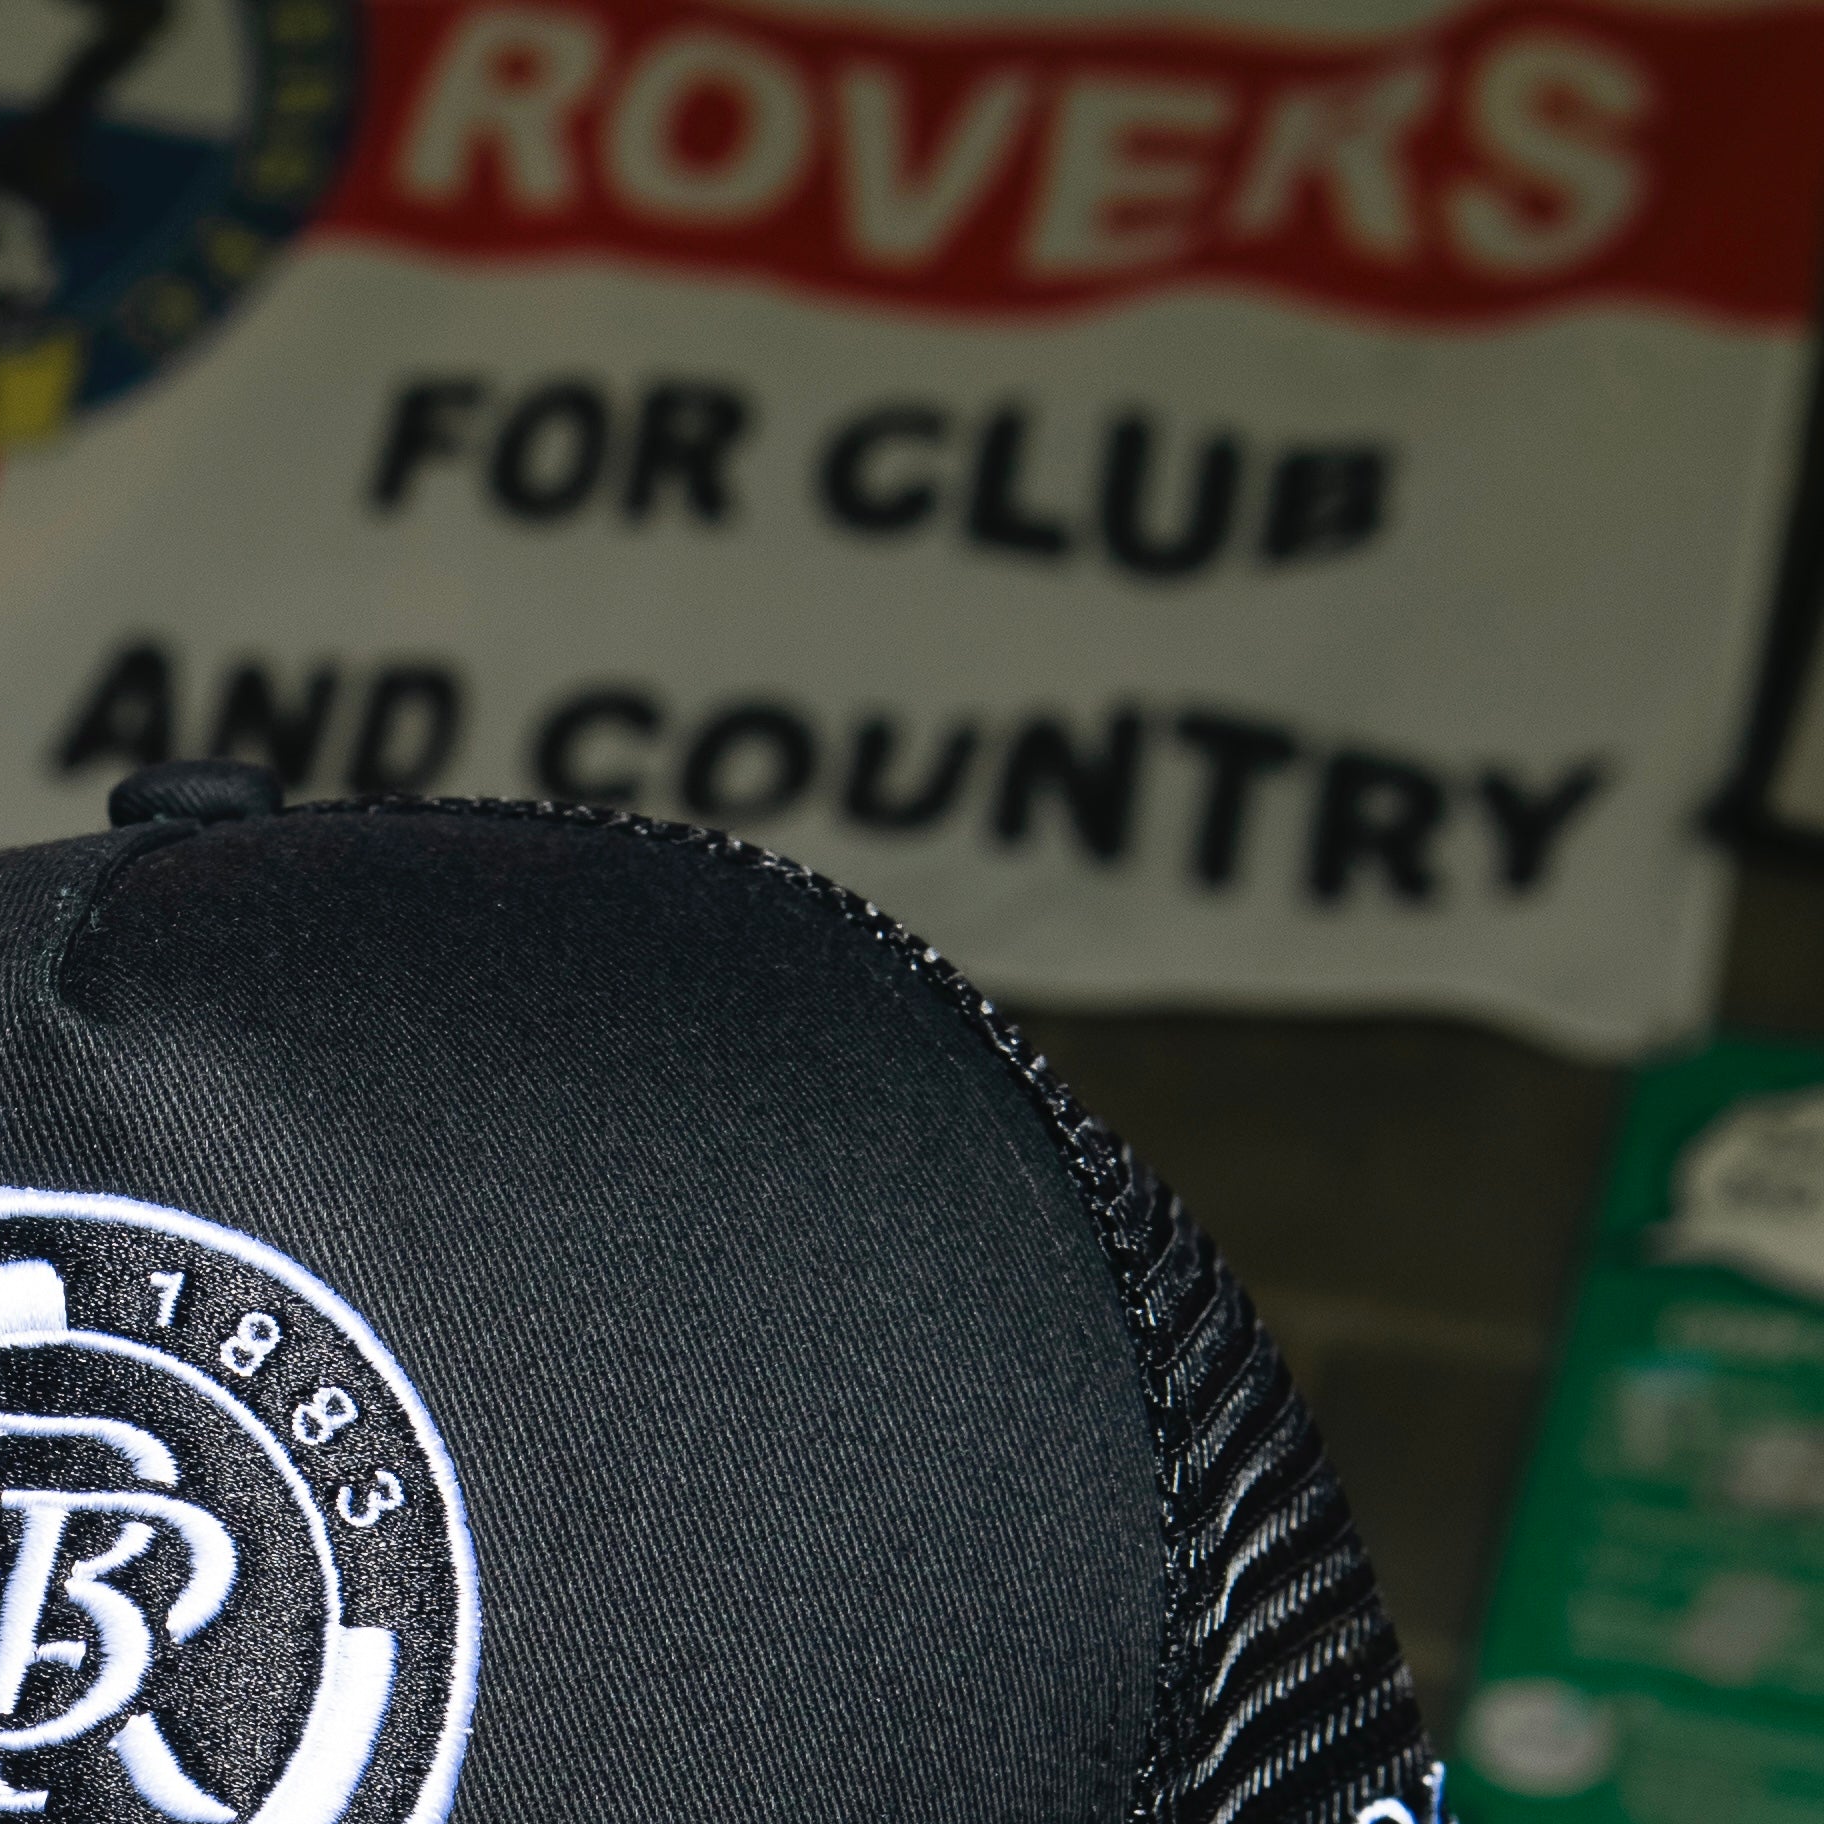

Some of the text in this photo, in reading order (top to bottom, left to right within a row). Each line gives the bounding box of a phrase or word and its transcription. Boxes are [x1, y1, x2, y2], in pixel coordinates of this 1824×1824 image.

[394, 8, 1656, 276] ROVERS
[366, 370, 1404, 585] FOR CLUB
[56, 640, 1611, 912] AND COUNTRY
[148, 1270, 404, 1528] 1883
